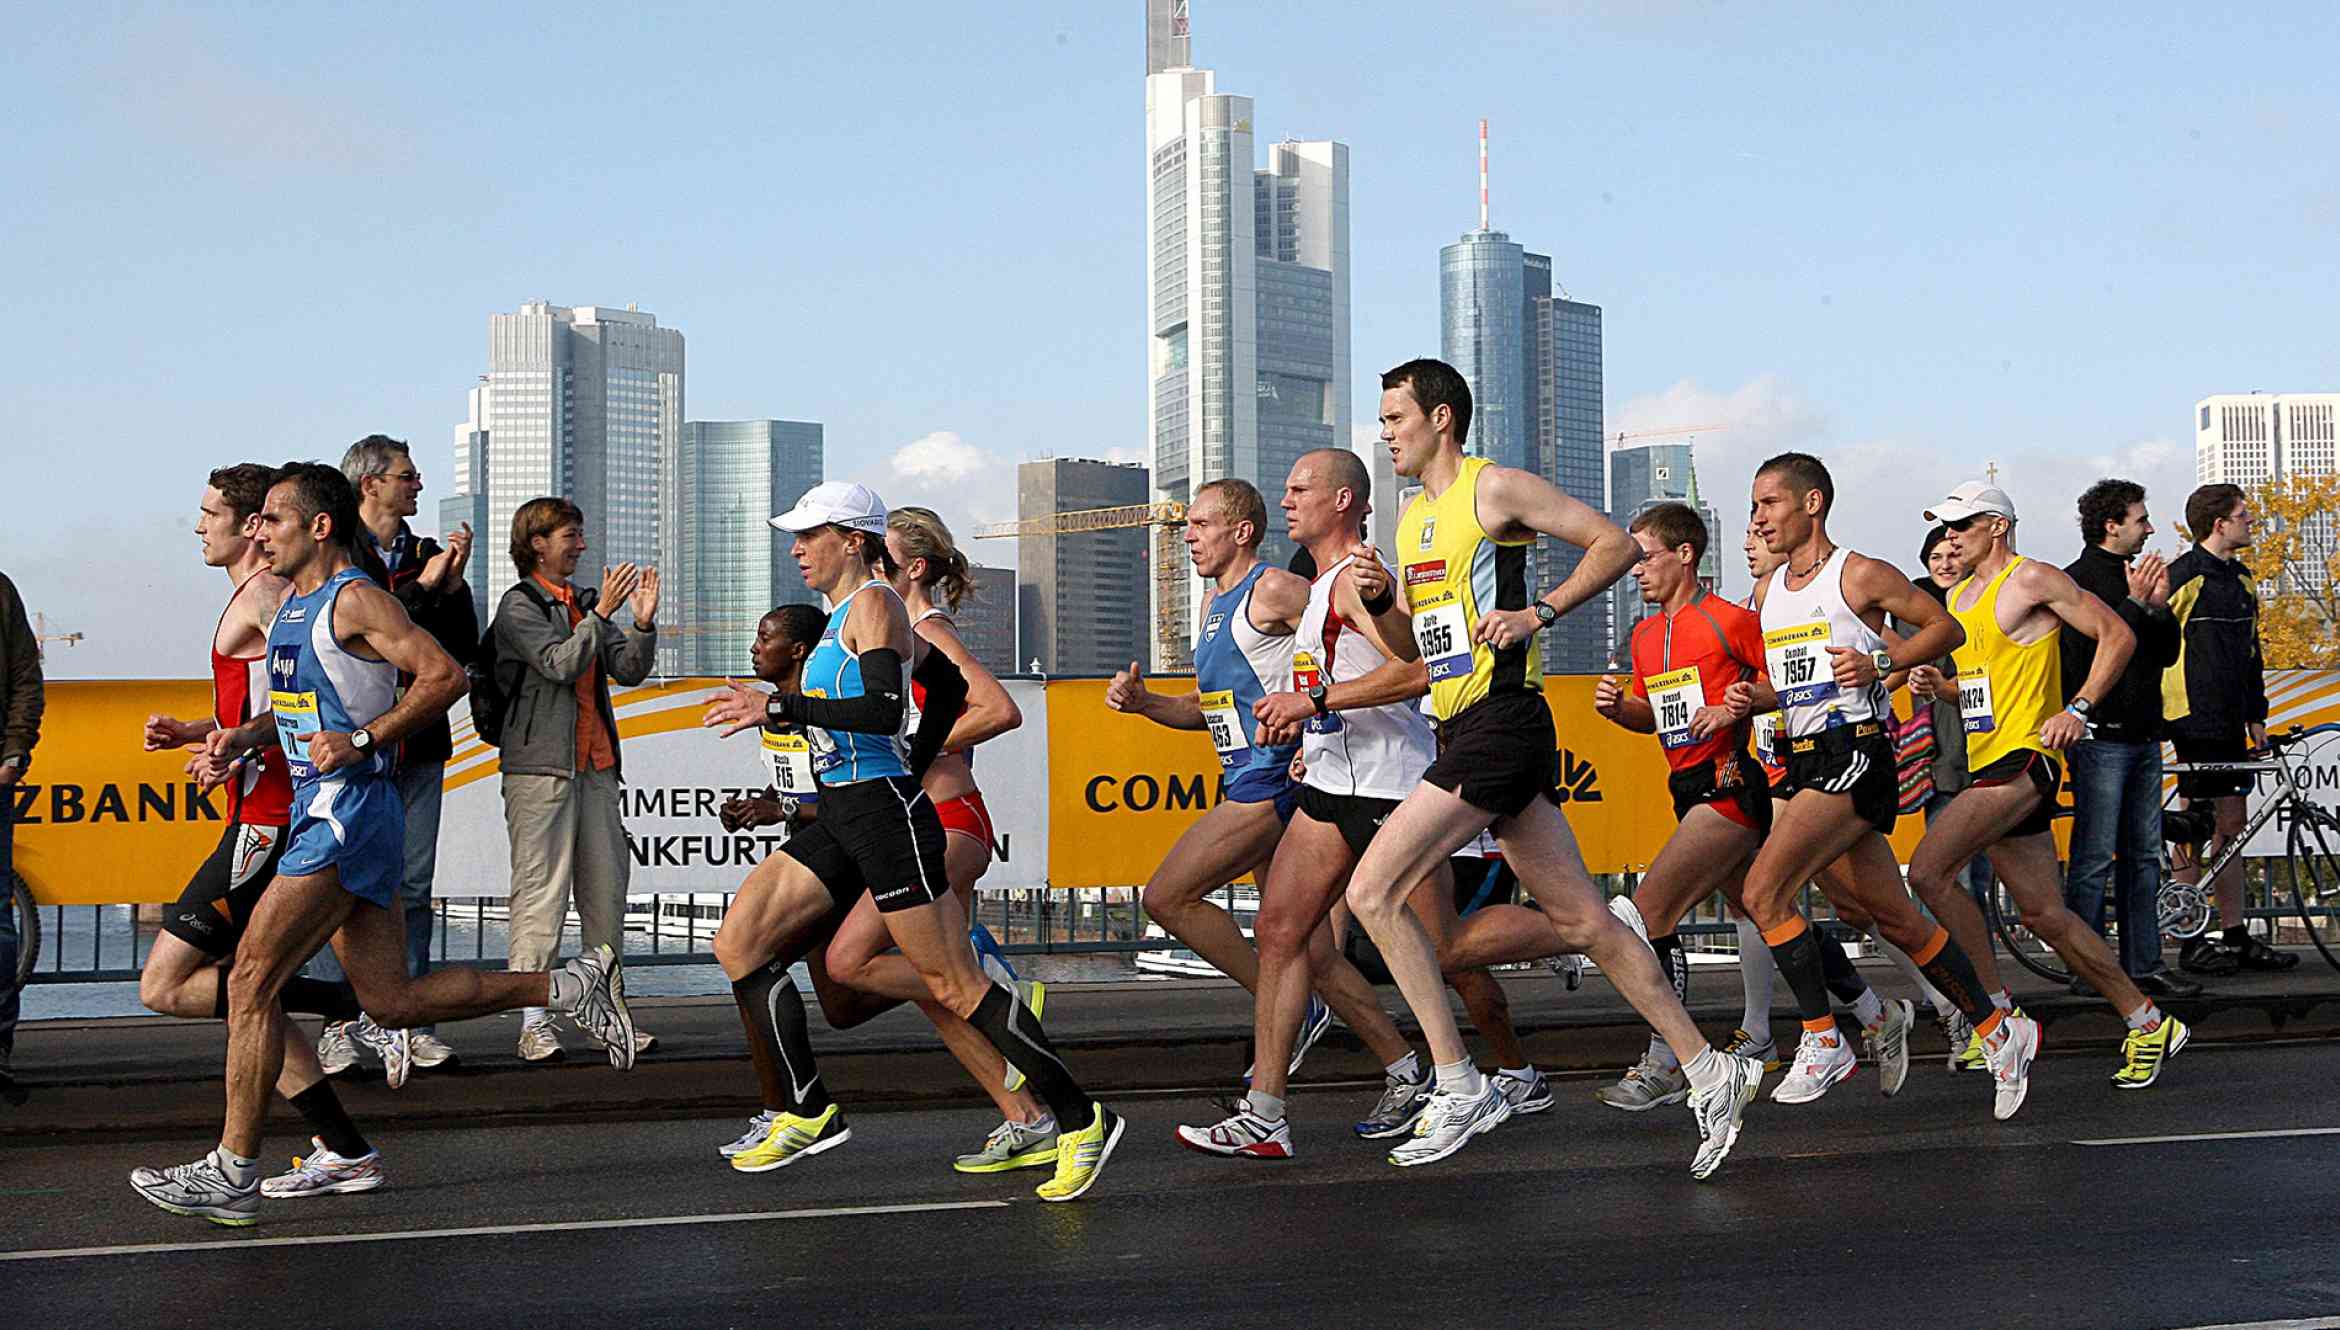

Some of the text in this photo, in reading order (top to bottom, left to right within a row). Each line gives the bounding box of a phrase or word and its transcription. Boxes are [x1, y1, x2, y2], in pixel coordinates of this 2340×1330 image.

[1420, 624, 1452, 658] 3955
[1783, 656, 1816, 686] 7957
[1661, 701, 1688, 729] 7814
[775, 765, 794, 789] F15
[13, 782, 221, 824] ZBANK
[1085, 774, 1227, 812] COM
[630, 835, 781, 866] NKFURT
